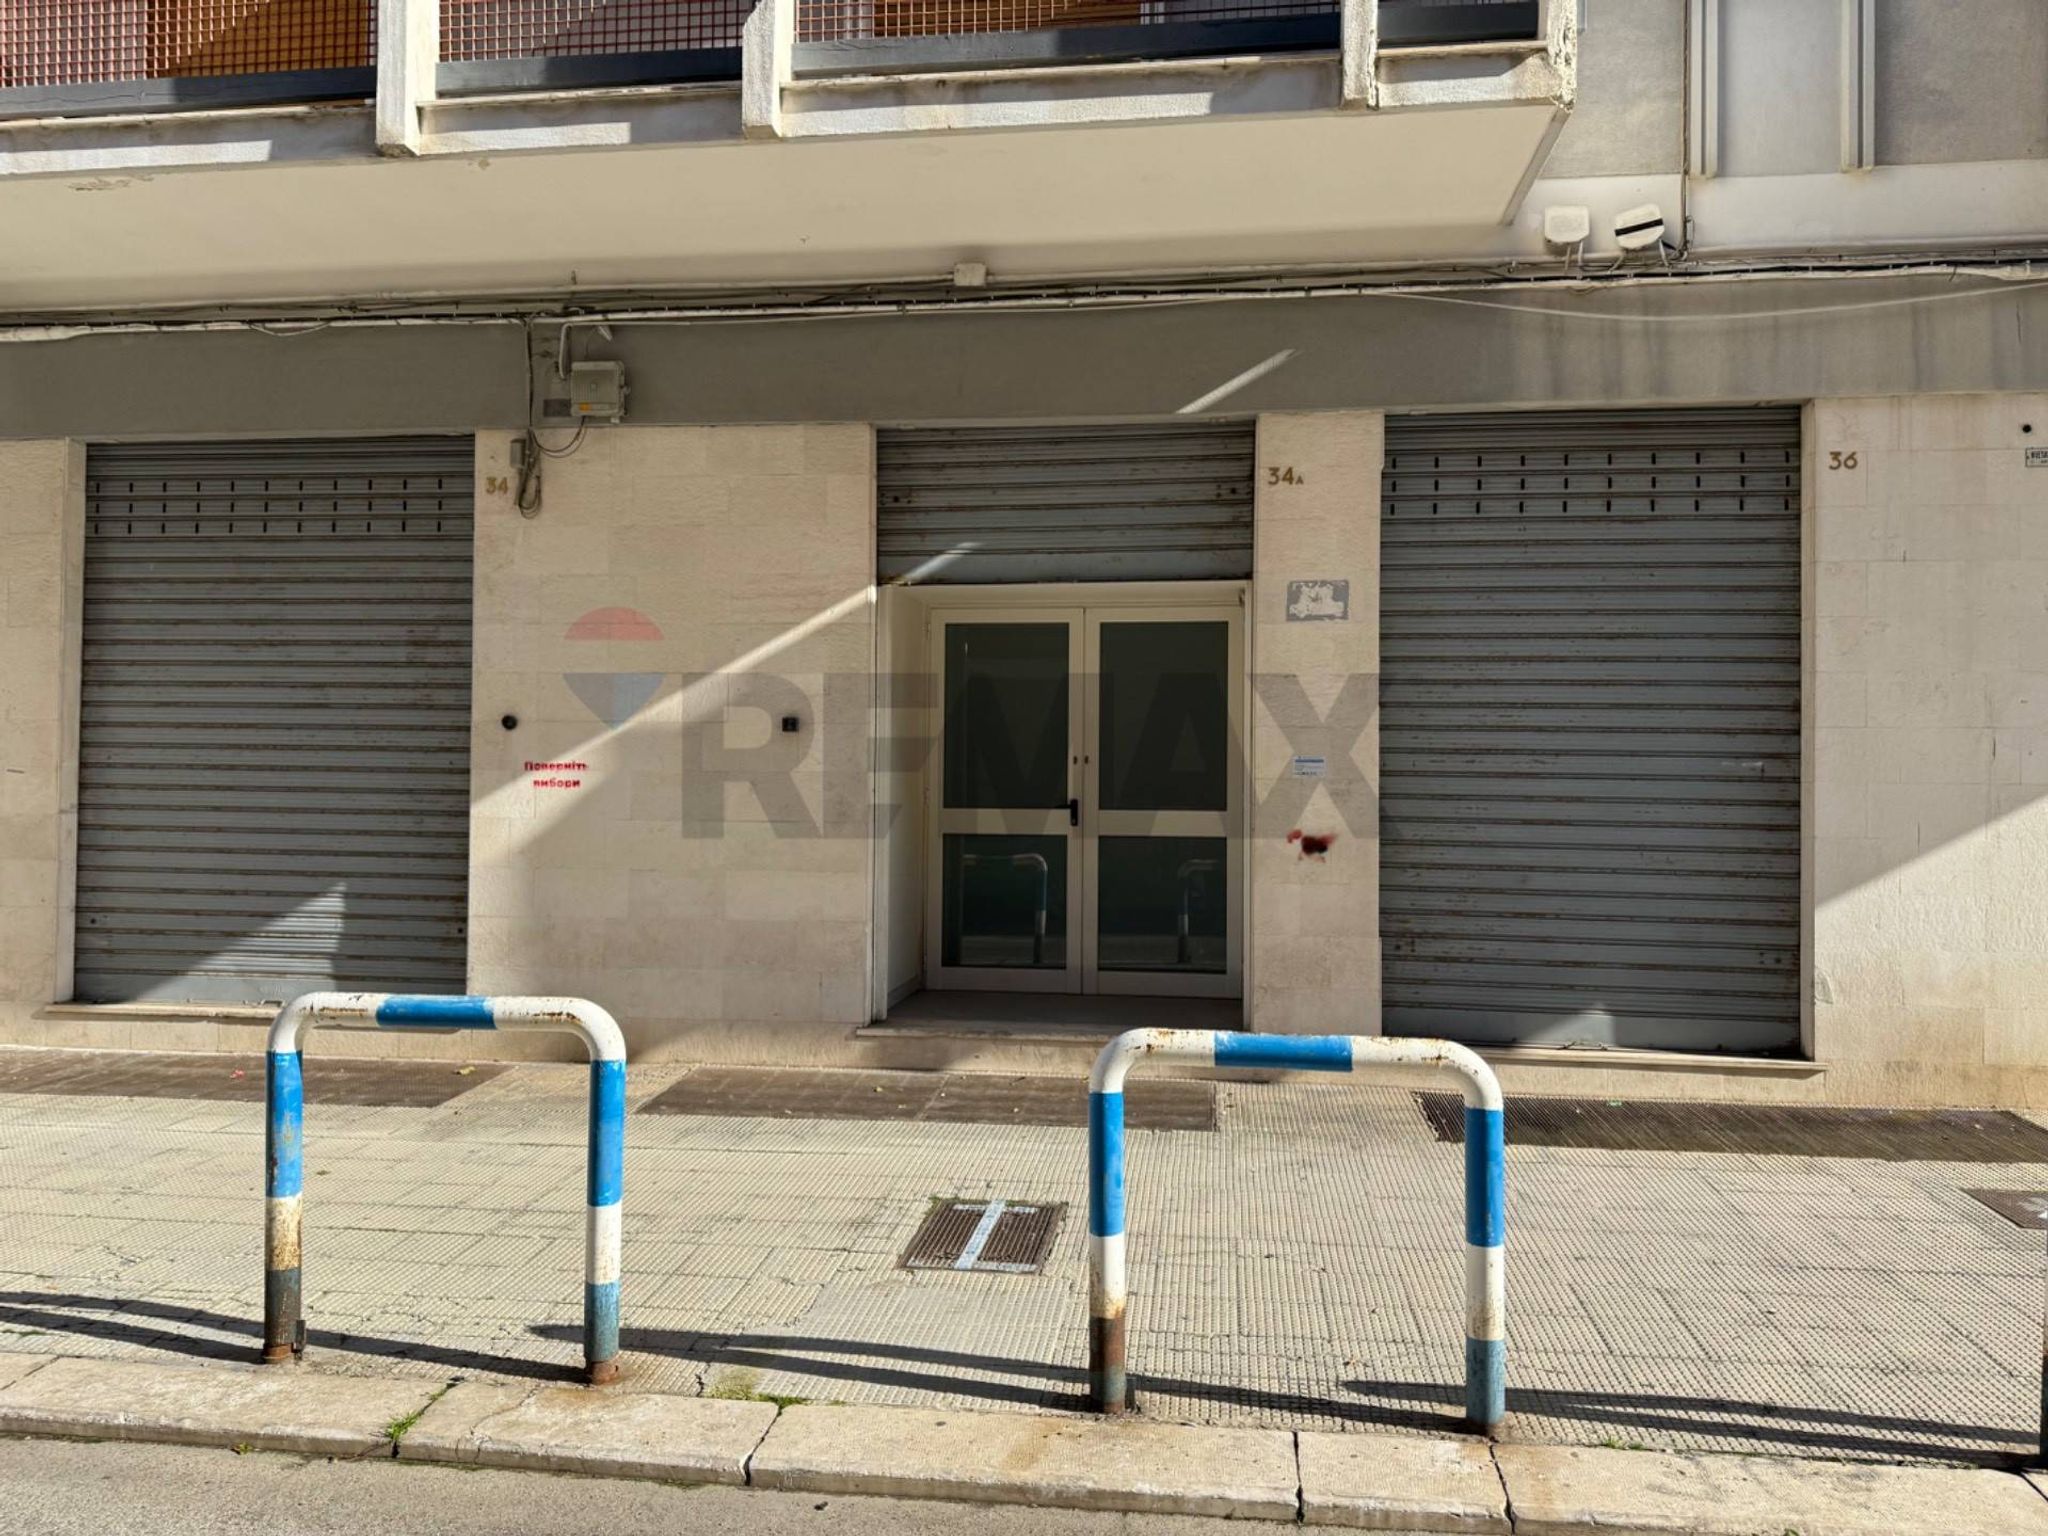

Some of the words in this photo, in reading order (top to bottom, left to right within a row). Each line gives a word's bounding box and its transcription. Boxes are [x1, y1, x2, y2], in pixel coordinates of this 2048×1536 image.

[1828, 451, 1858, 470] 36
[1267, 466, 1305, 486] 34A
[485, 477, 510, 495] 34
